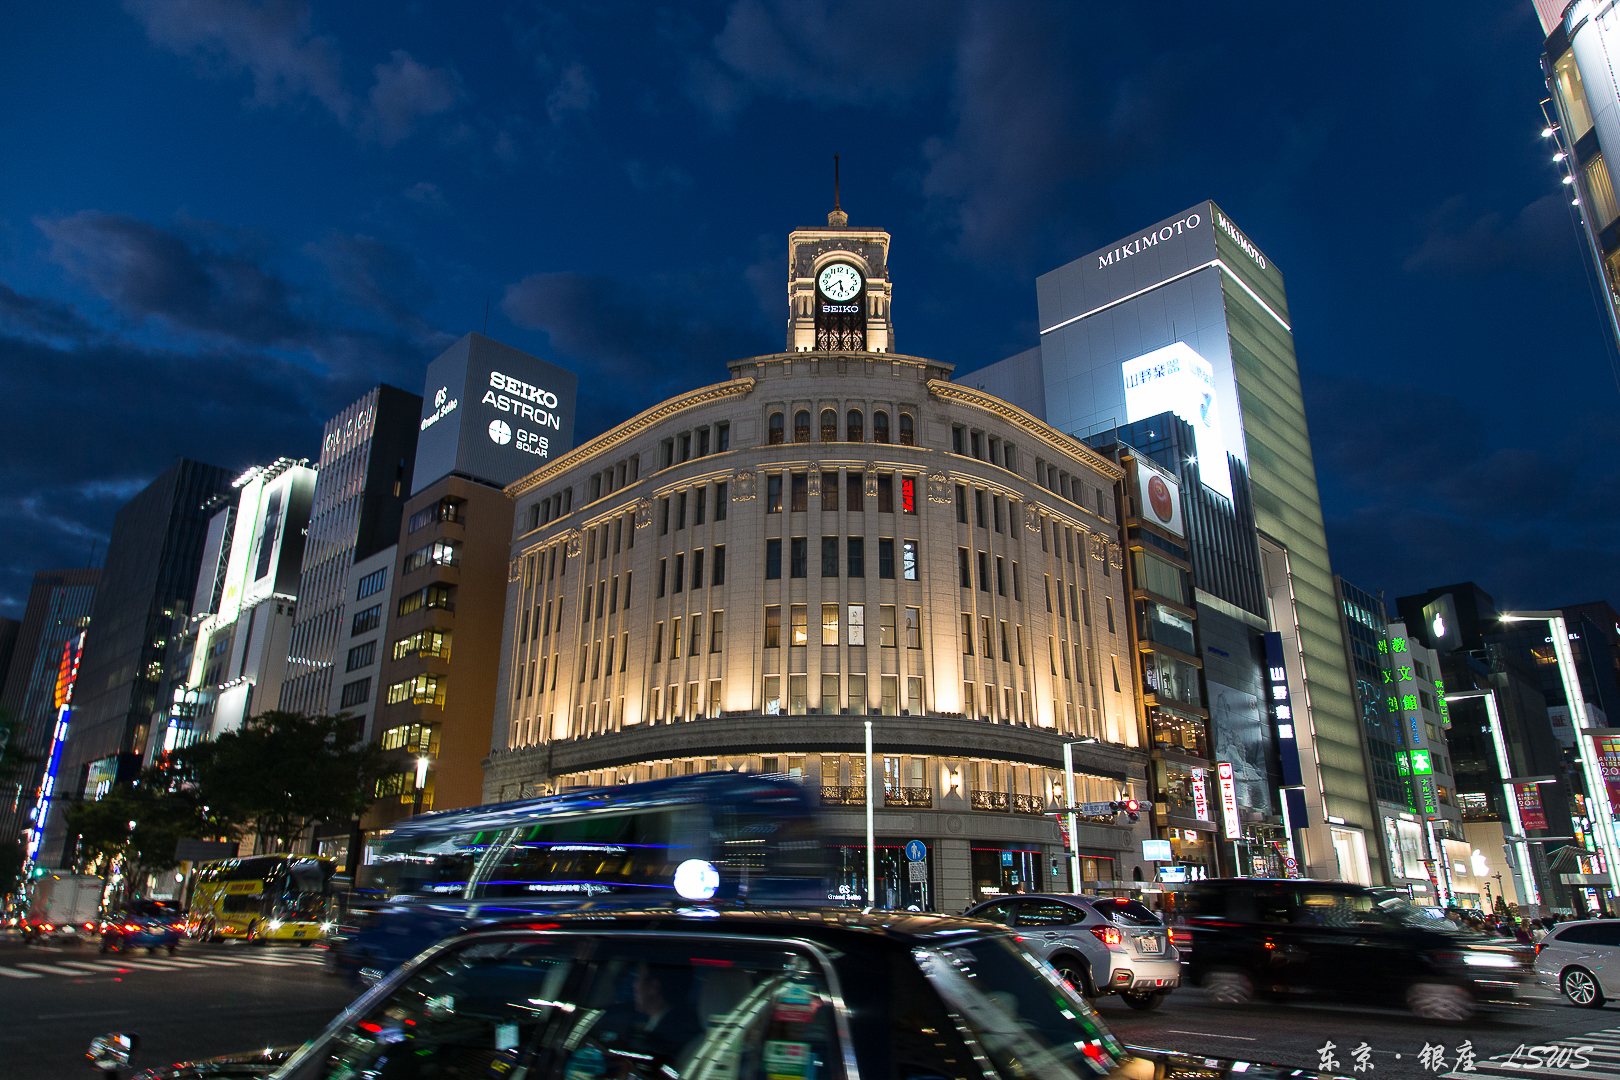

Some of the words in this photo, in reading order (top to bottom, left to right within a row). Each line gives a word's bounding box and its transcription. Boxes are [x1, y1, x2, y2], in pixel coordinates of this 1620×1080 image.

[1098, 213, 1201, 270] MIKIMOTO
[1217, 213, 1266, 270] MIKIMOTO
[490, 371, 558, 410] SEIKO
[1125, 358, 1180, 389] 山野楽器
[420, 409, 440, 432] Grand
[440, 398, 458, 418] Seiko
[482, 390, 560, 430] ASTRON
[516, 428, 549, 450] GPS
[516, 441, 548, 458] SOLAR
